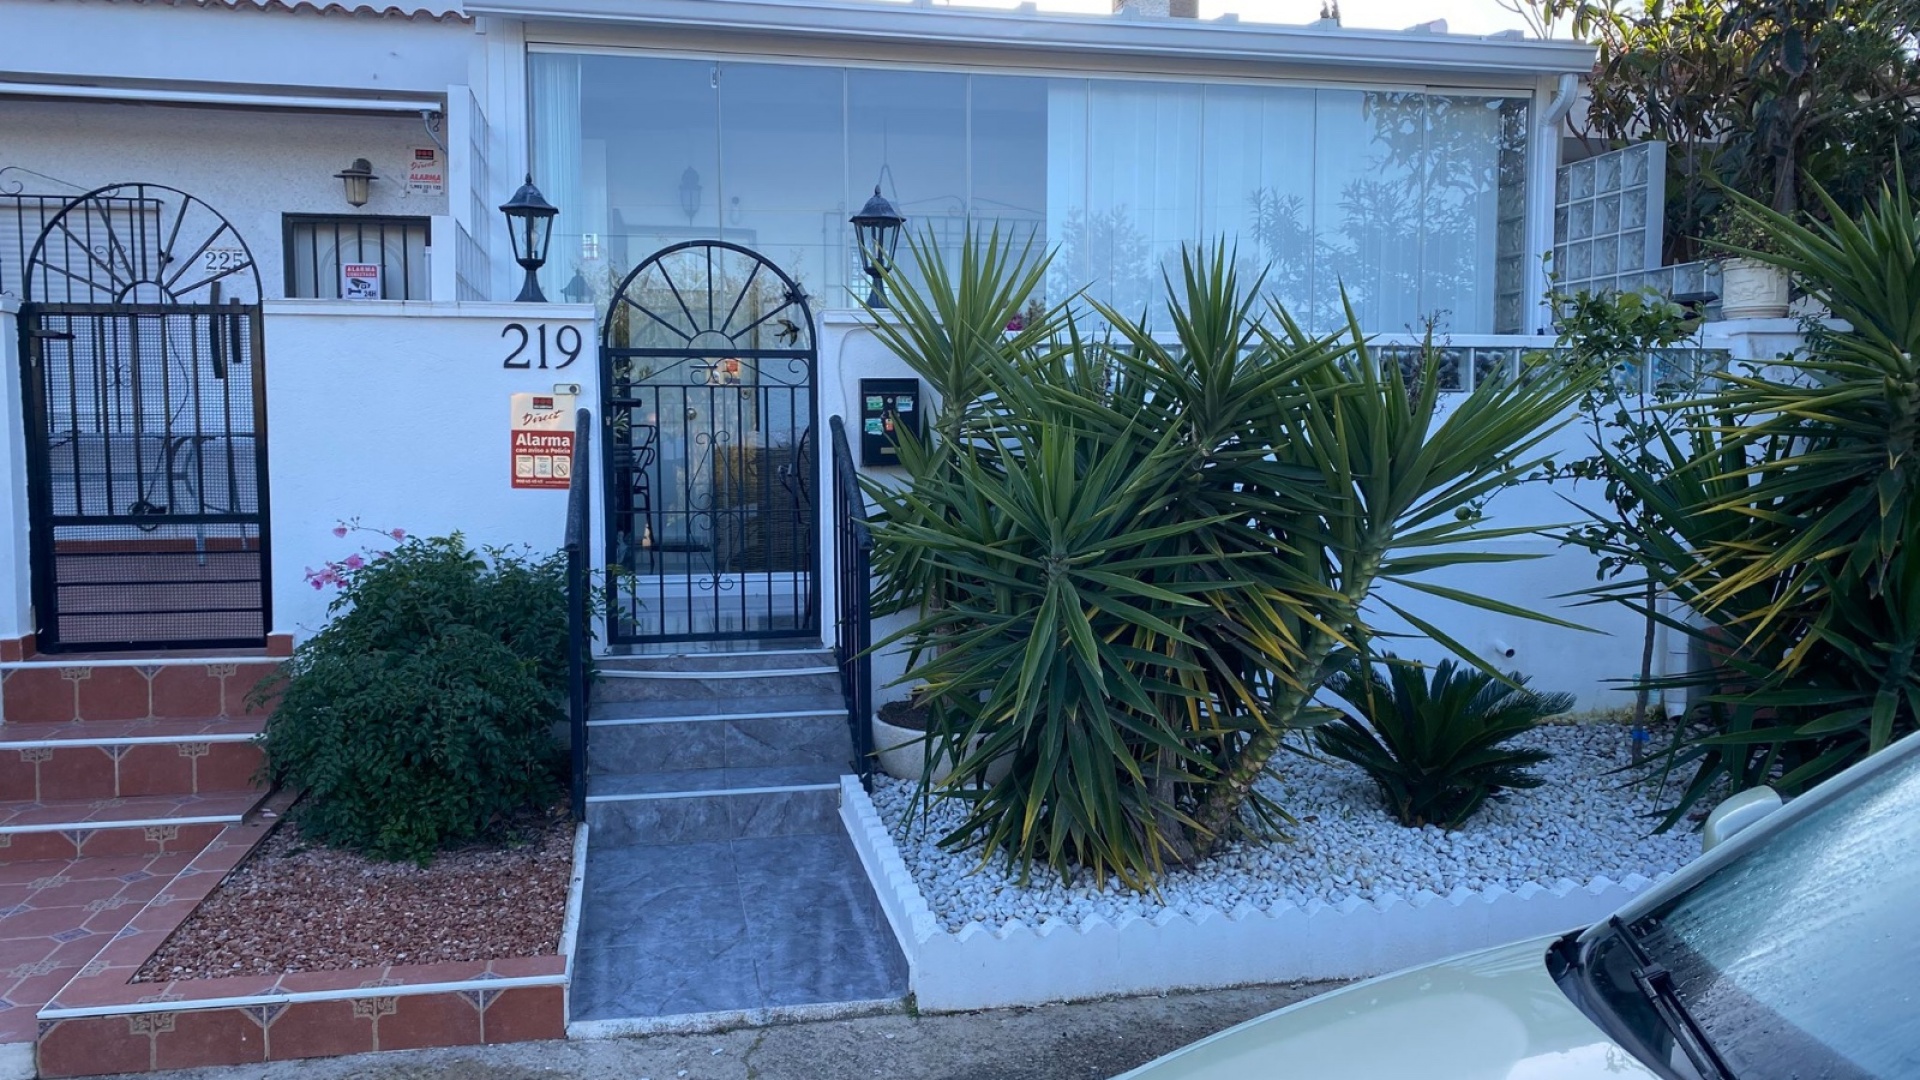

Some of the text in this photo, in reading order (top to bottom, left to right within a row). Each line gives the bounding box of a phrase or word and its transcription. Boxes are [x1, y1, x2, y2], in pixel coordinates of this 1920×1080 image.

[410, 173, 441, 182] ALARMA
[205, 251, 244, 270] 225
[501, 323, 582, 370] 219
[522, 409, 564, 426] Direct
[516, 433, 571, 447] Alarma
